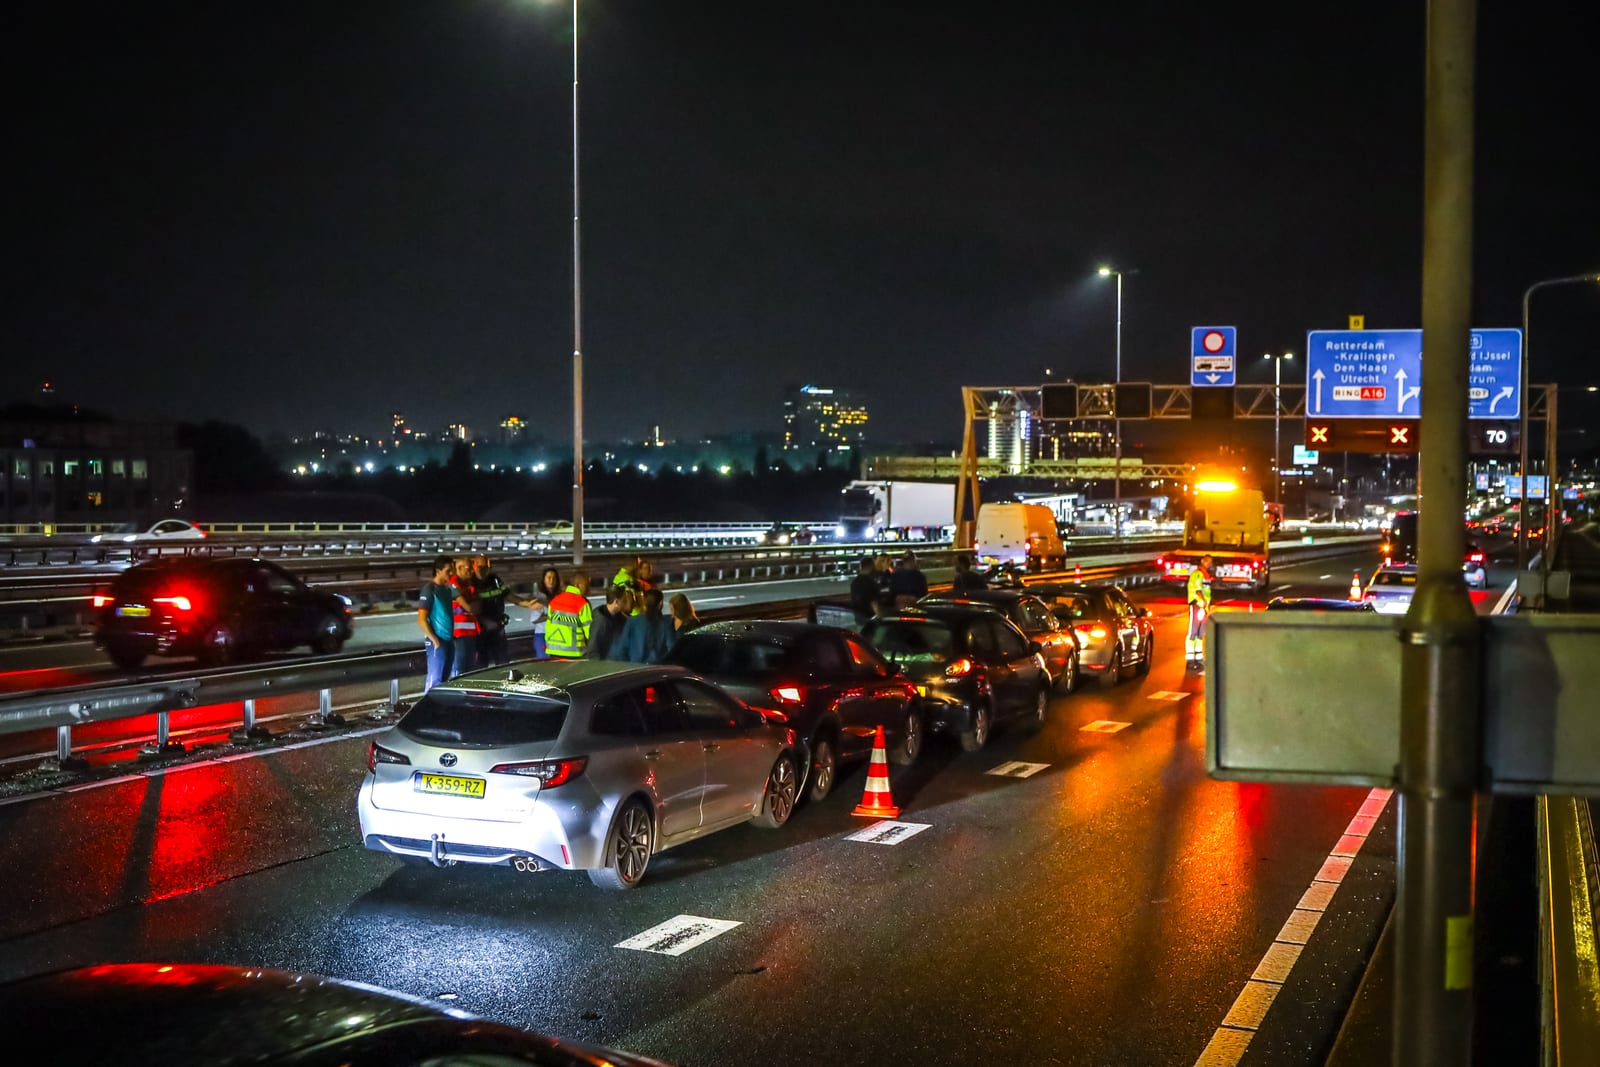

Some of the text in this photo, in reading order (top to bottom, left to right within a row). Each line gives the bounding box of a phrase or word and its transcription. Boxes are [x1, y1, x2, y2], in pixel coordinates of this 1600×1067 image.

[1326, 341, 1385, 350] Rotterdam
[1334, 352, 1395, 363] -Kralingen
[1480, 351, 1511, 361] IJssel
[1334, 363, 1388, 374] Den Haag
[1341, 375, 1380, 383] Utrecht
[1335, 388, 1384, 398] RING A16
[1486, 430, 1507, 443] 70
[425, 776, 480, 794] K-359-RZ
